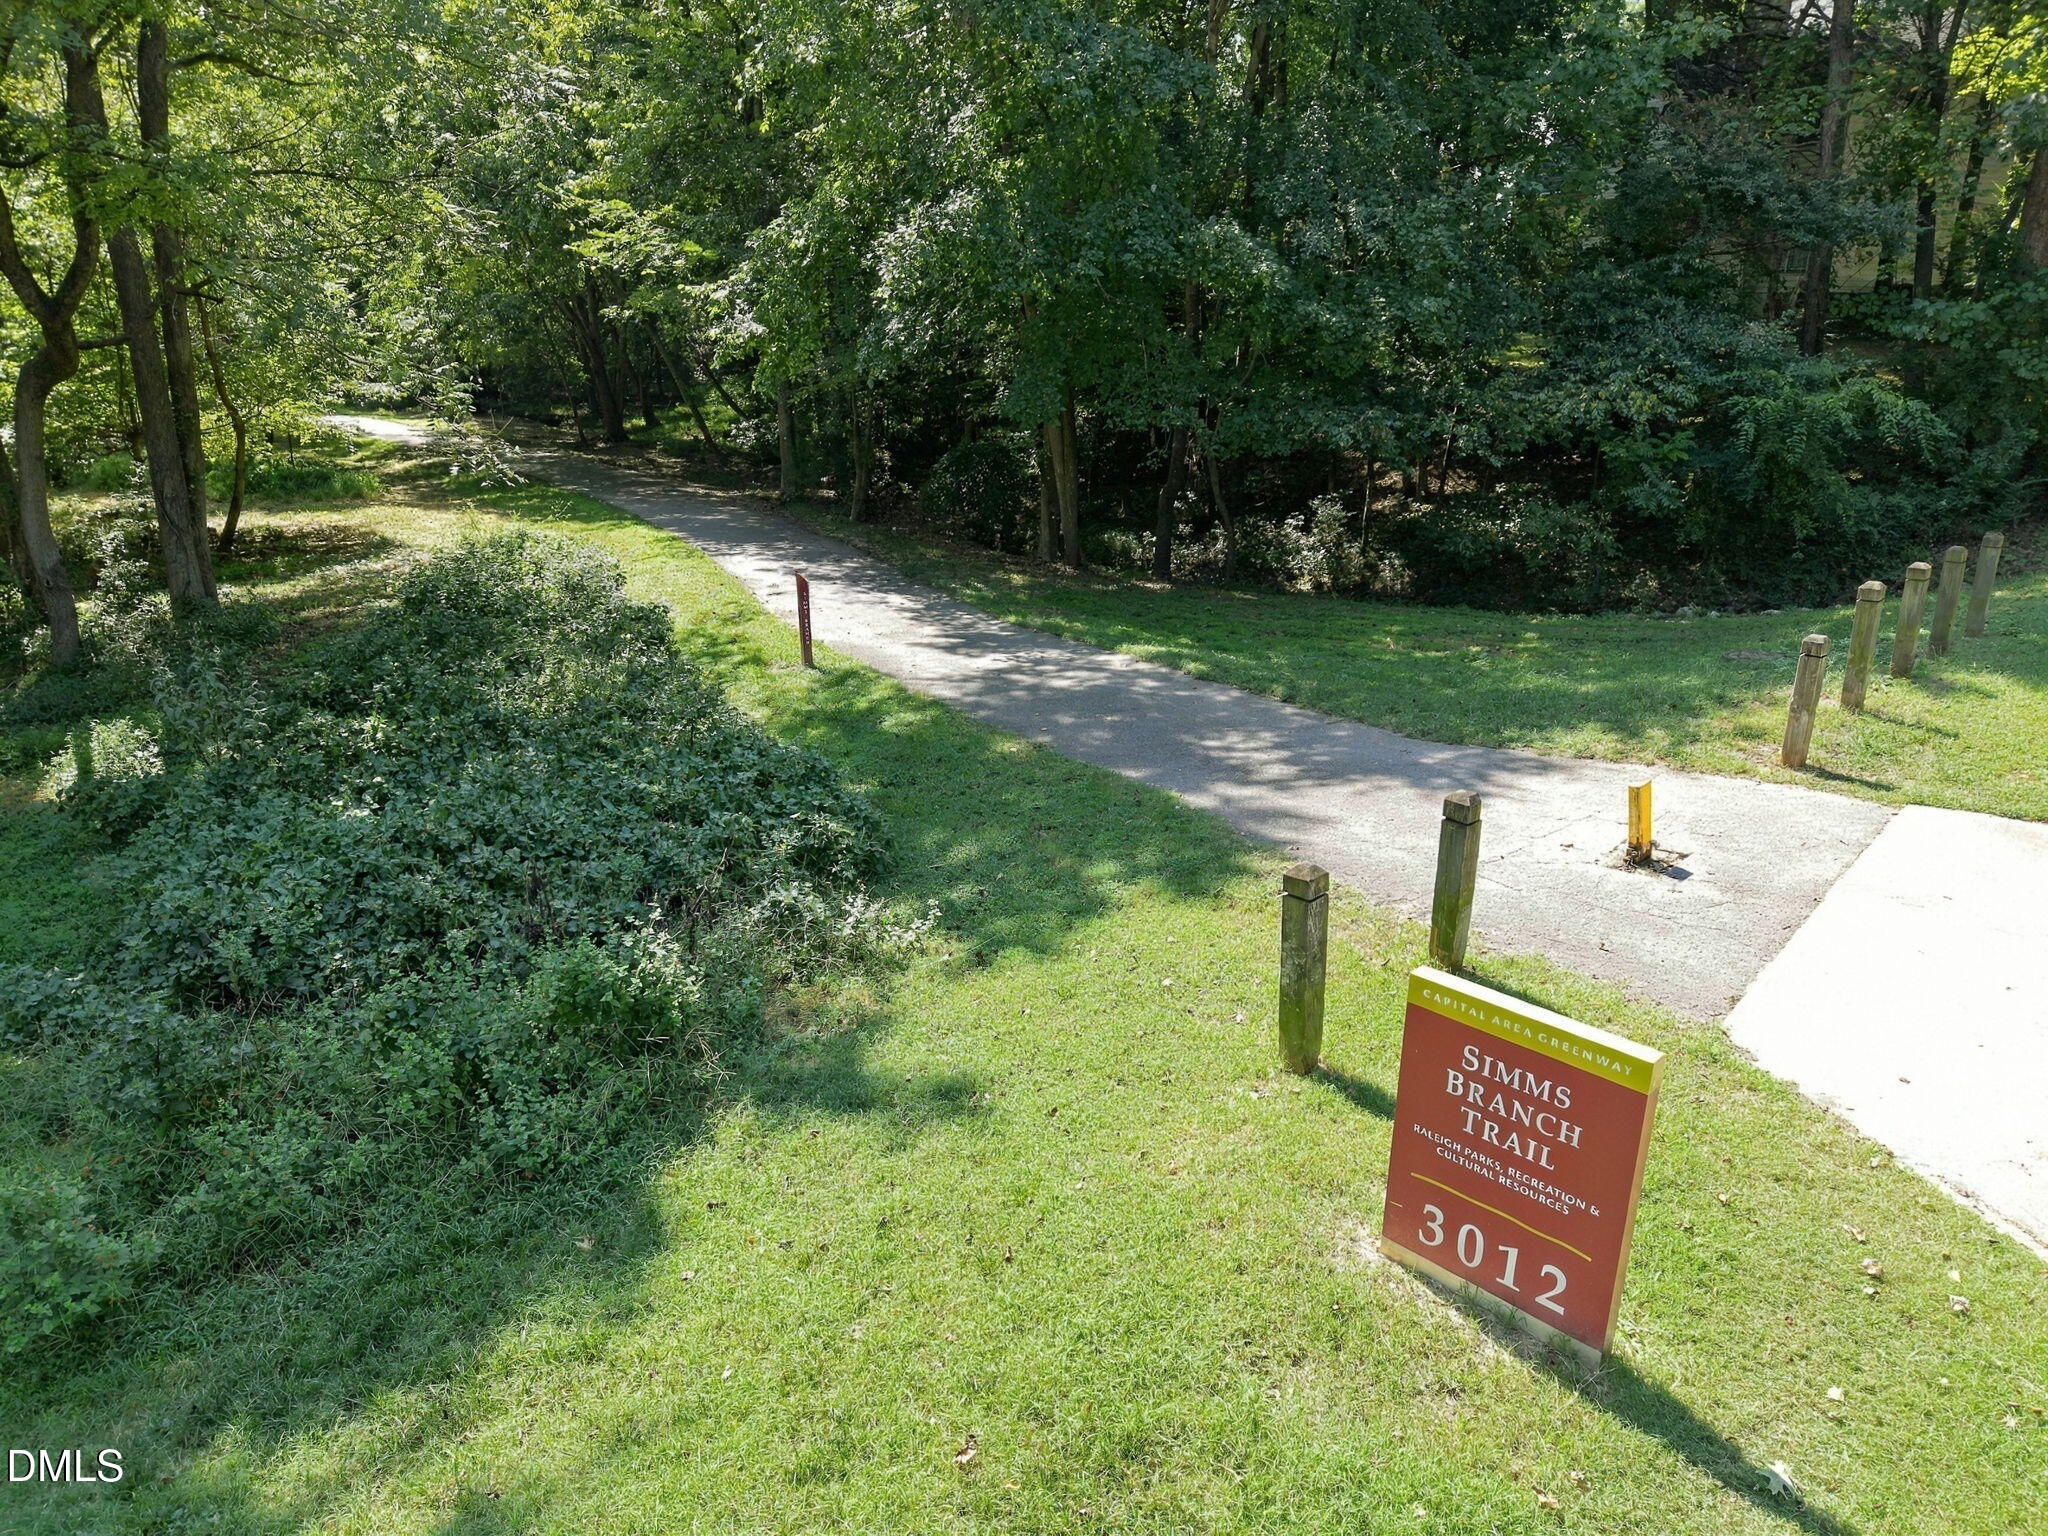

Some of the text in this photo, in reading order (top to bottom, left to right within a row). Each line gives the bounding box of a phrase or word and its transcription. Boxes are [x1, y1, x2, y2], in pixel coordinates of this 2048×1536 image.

[1423, 989, 1632, 1075] CAPITAL AREA GREENWAY
[1446, 1068, 1583, 1149] BRANCH
[1461, 1045, 1572, 1109] SIMMS
[1413, 1124, 1600, 1217] RALEIGH PARKS, RECREATION &
[1460, 1107, 1555, 1170] TRAIL
[1436, 1146, 1569, 1215] CULTURAL RESOURCES
[1418, 1203, 1568, 1316] 3012
